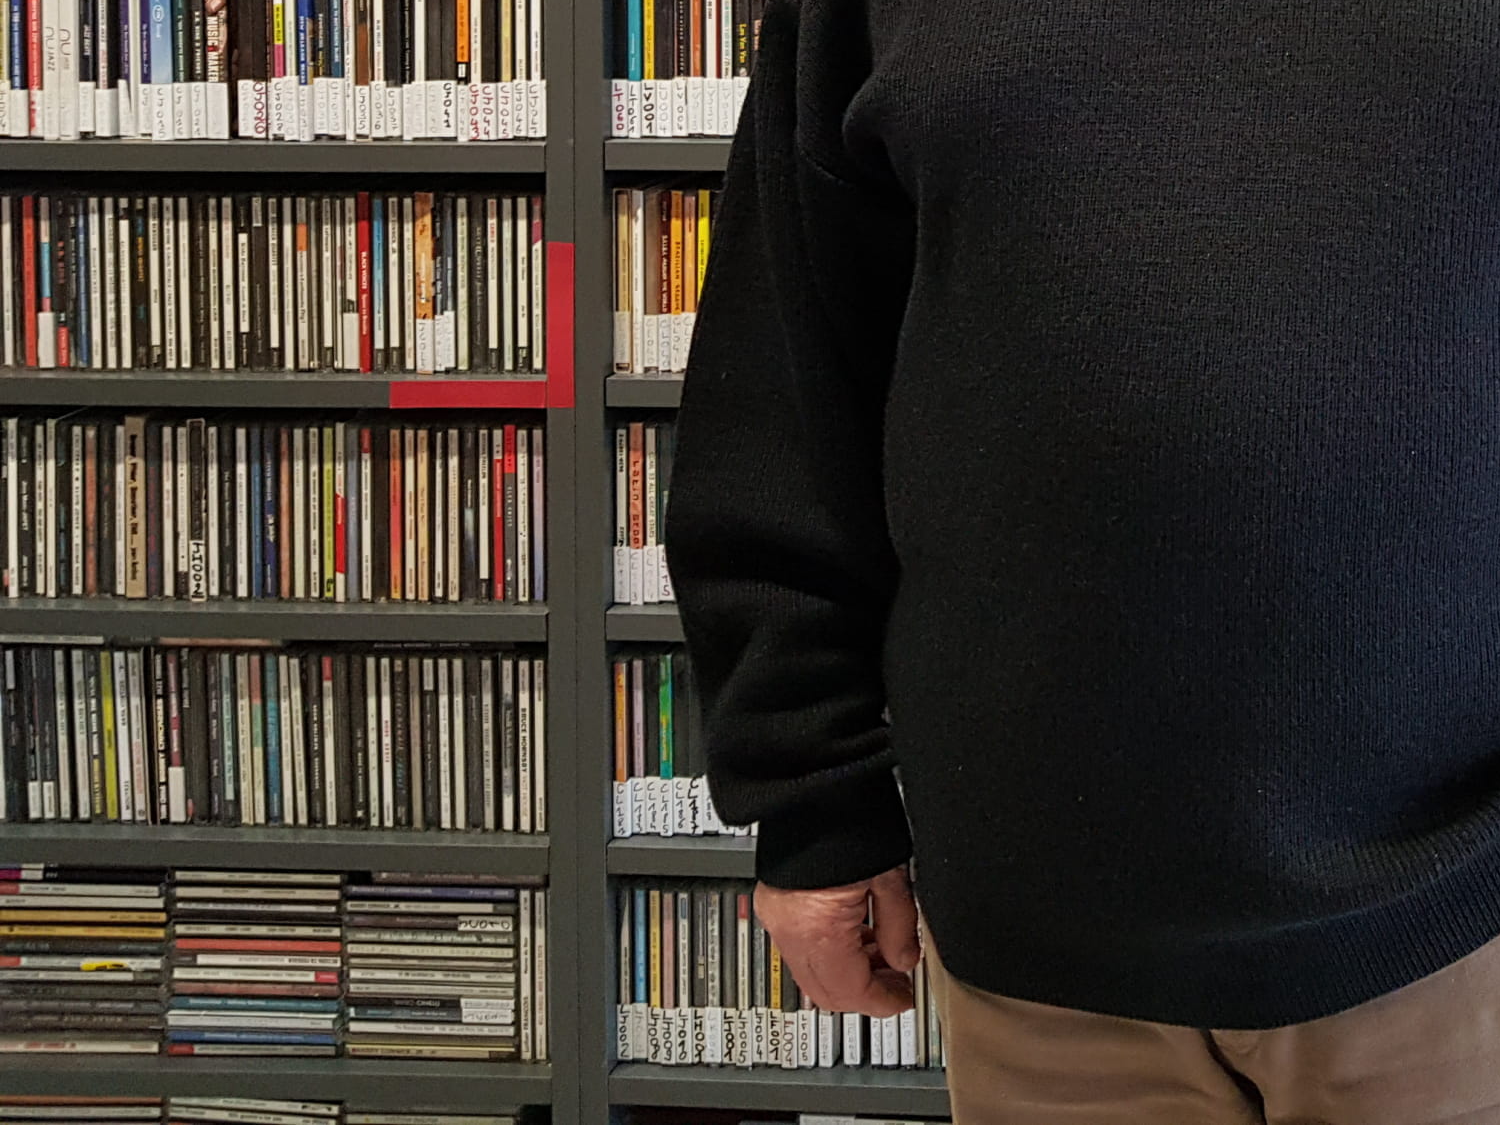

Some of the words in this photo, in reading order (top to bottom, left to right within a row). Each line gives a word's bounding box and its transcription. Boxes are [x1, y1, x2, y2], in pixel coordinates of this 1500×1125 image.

[207, 16, 219, 46] MUSIC
[520, 708, 528, 732] BRUCE
[520, 734, 528, 773] HORNSBY
